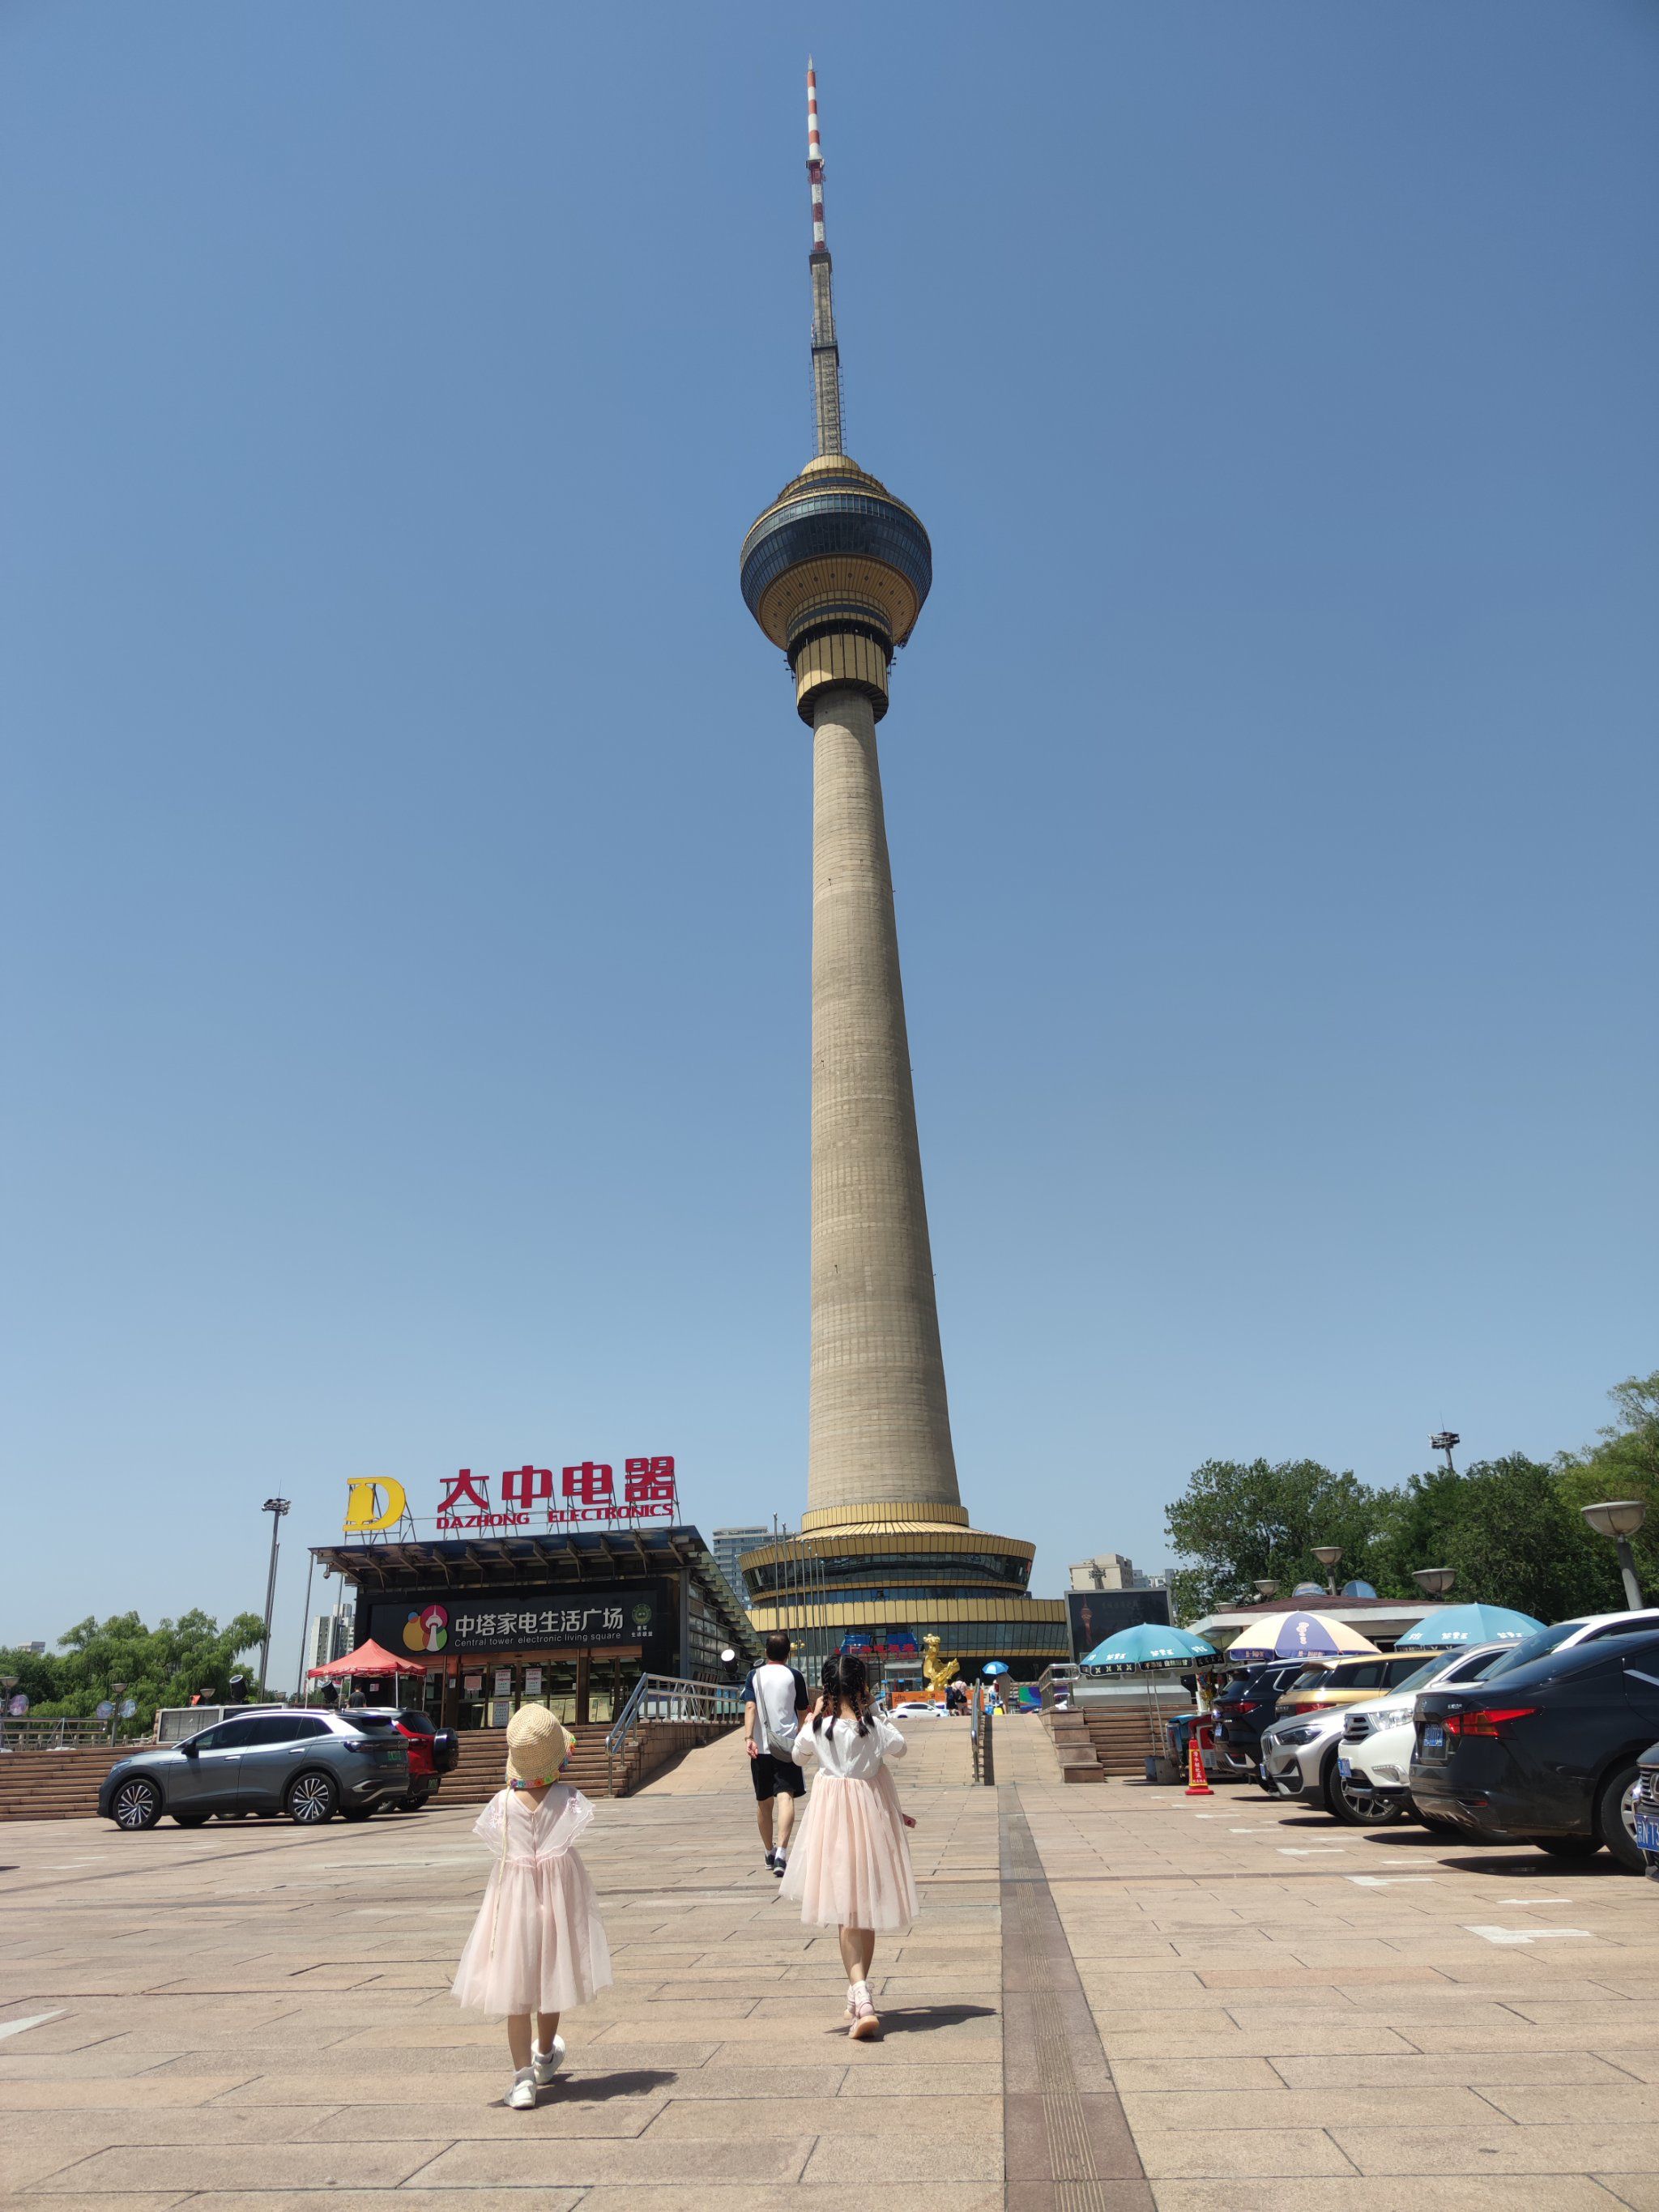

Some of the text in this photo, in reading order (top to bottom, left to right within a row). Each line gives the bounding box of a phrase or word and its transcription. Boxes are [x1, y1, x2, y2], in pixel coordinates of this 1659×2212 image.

[437, 1455, 674, 1513] 大中电器
[436, 1503, 674, 1529] DAZHONG ELECTRONICS
[455, 1607, 624, 1638] 中塔家电生活广场
[454, 1632, 621, 1647] Central tower electronic living square
